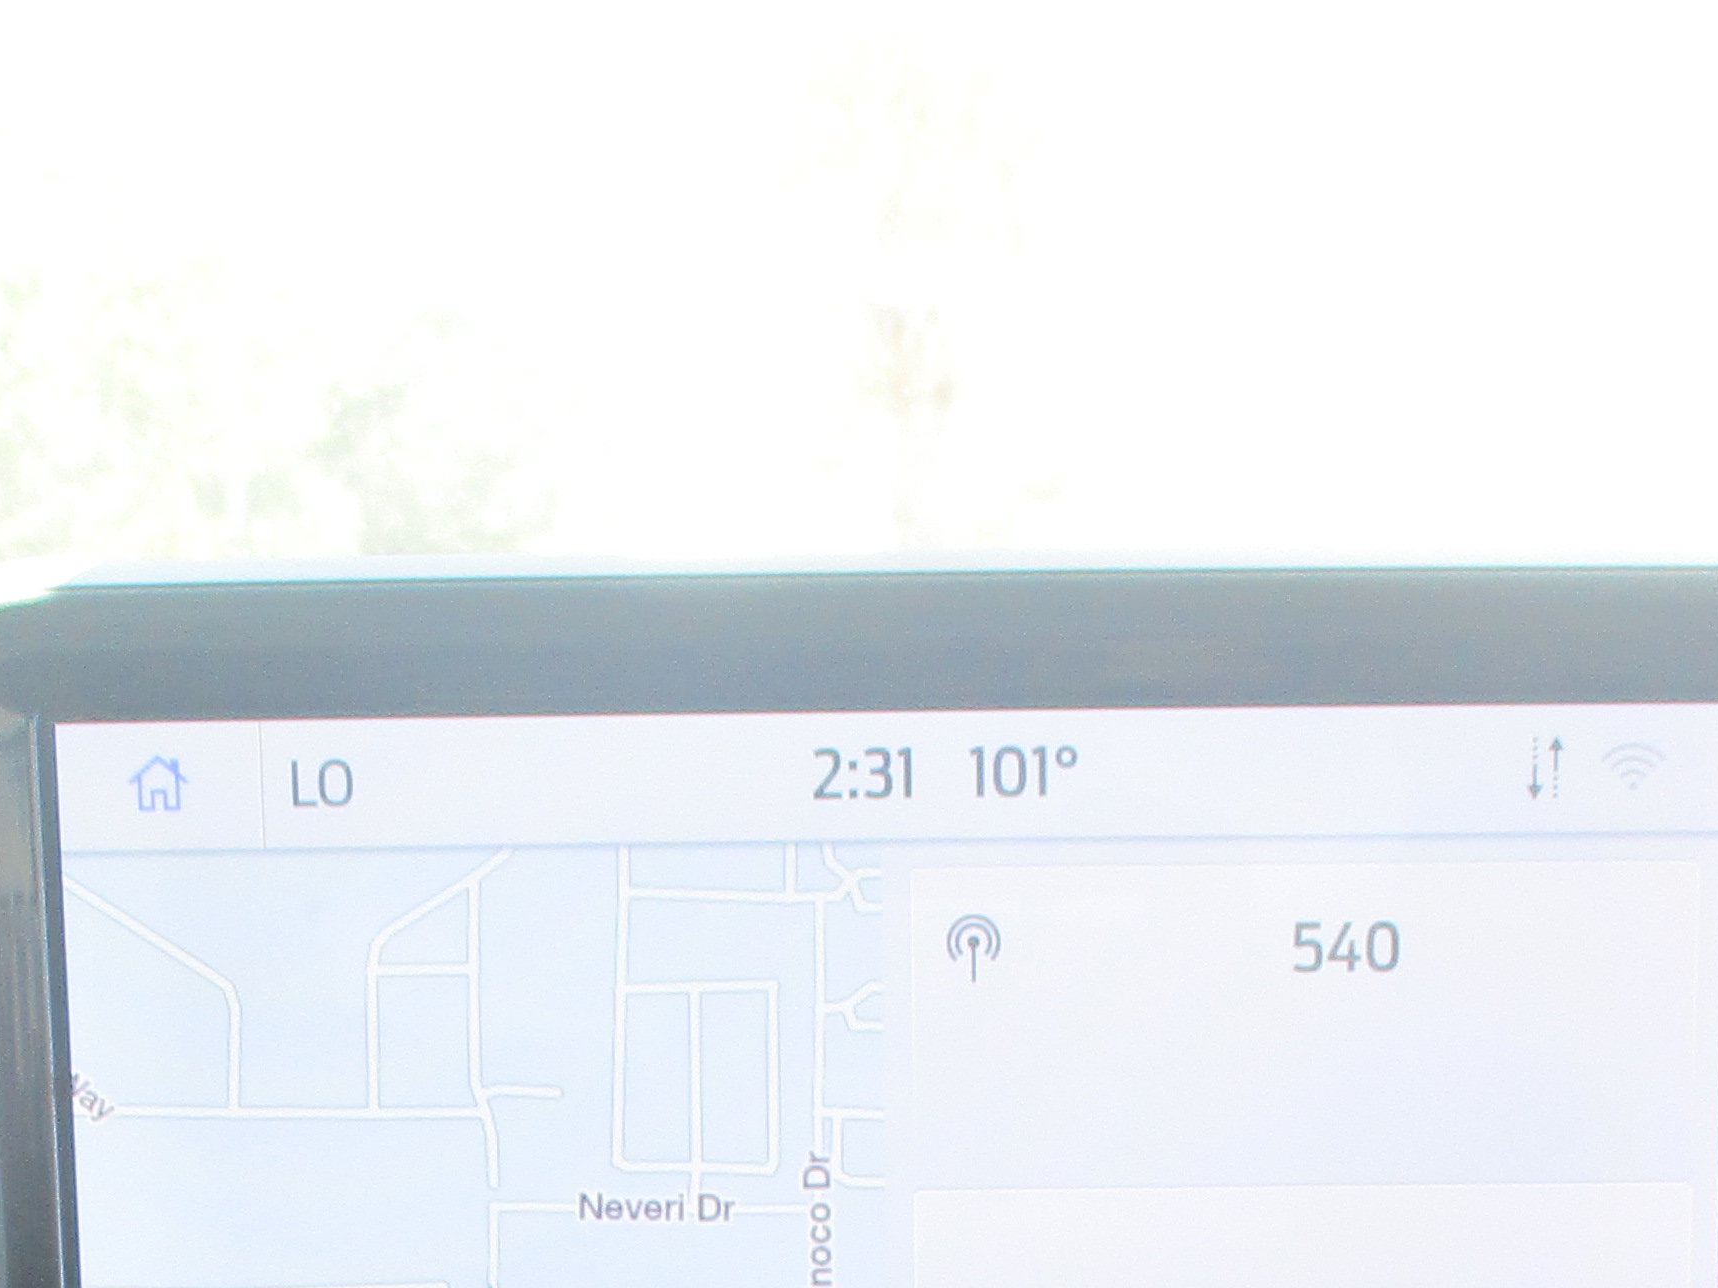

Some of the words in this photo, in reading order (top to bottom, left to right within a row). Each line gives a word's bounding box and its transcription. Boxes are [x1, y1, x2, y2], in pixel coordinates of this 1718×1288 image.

[289, 758, 355, 808] LO
[812, 747, 915, 800] 2:31
[968, 745, 1079, 799] 101°
[1292, 921, 1401, 972] 540
[802, 1150, 831, 1190] Dr
[578, 1193, 685, 1221] Neveri
[696, 1194, 735, 1223] Dr
